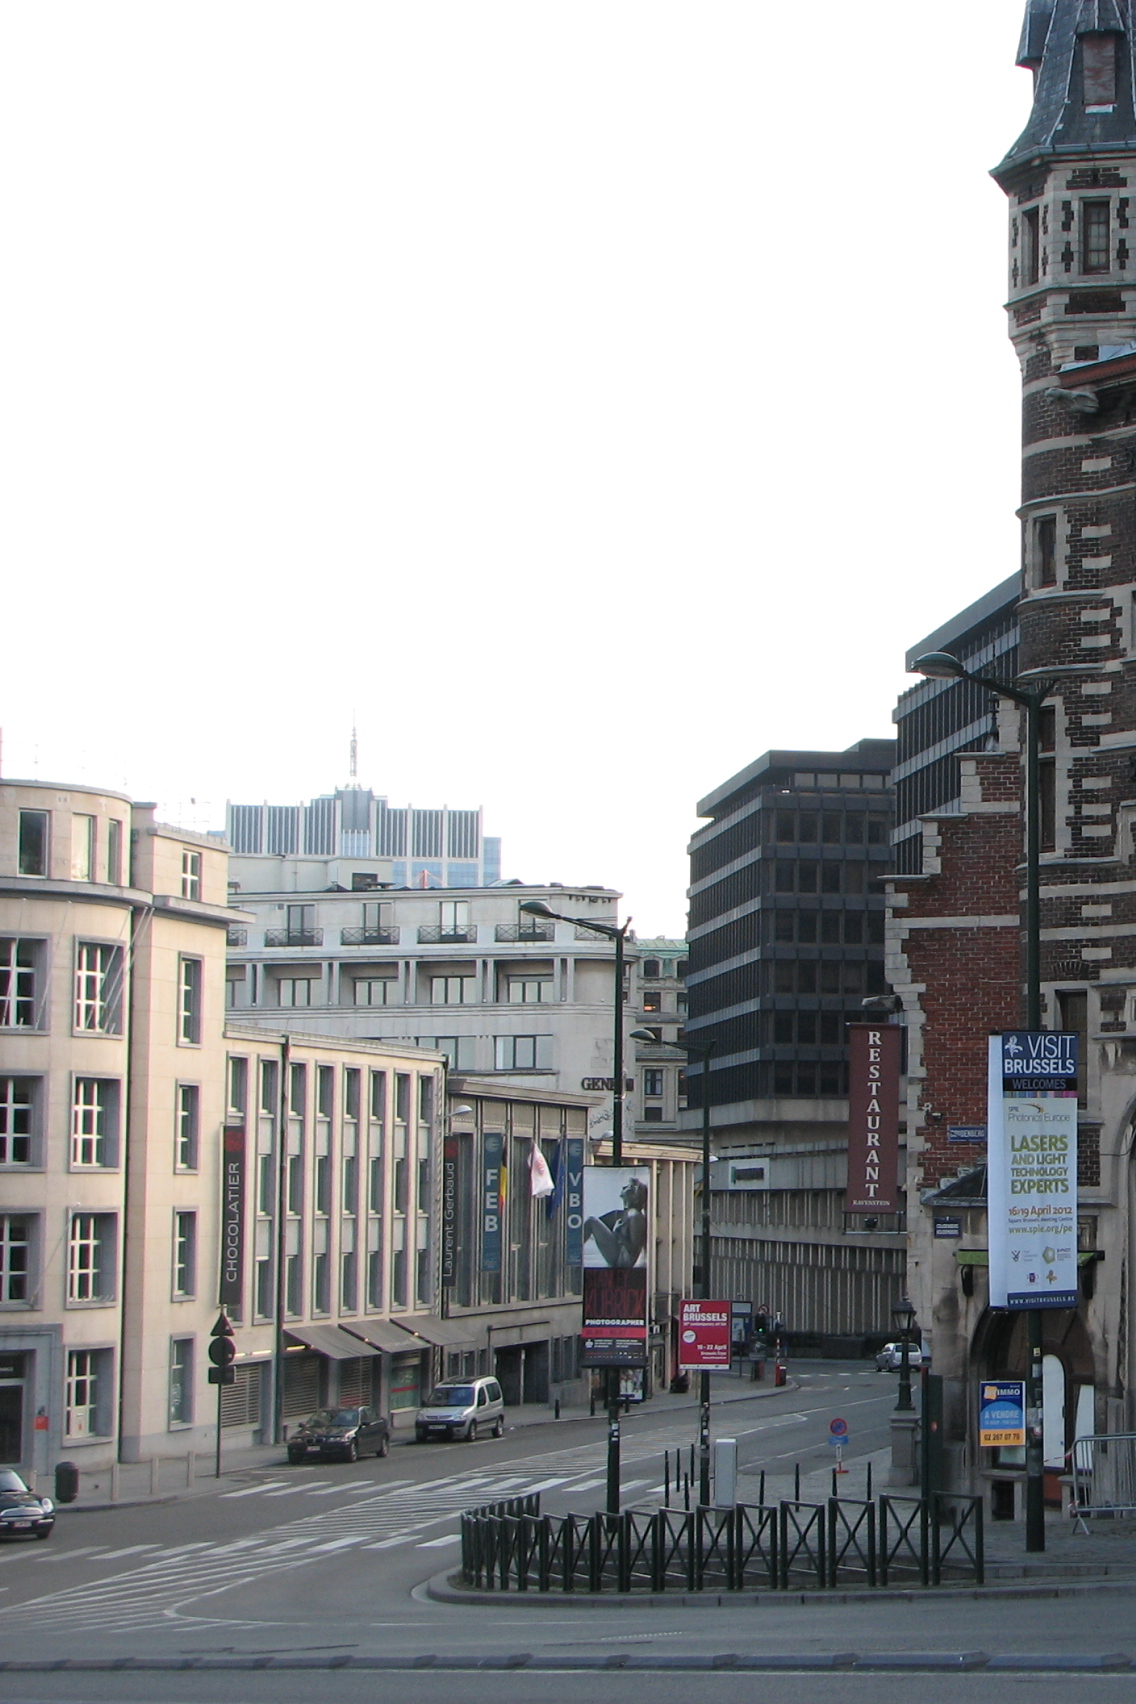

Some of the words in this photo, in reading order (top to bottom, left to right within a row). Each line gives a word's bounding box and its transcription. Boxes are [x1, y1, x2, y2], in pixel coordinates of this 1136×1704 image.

[1028, 1035, 1075, 1058] VISIT
[1004, 1059, 1075, 1073] BRUSSELS
[1012, 1079, 1066, 1089] WELCOMES
[865, 1031, 882, 1197] RESTAURANT
[1008, 1113, 1041, 1122] Photonics
[1043, 1113, 1071, 1122] Europe
[1011, 1135, 1068, 1152] LASERS
[1011, 1154, 1035, 1165] AND
[1036, 1153, 1068, 1165] LIGHT
[1010, 1167, 1068, 1177] TECHNOLOGY
[443, 1162, 455, 1220] Gerbaud
[1011, 1178, 1069, 1194] EXPERTS
[484, 1169, 499, 1232] FEB
[568, 1172, 582, 1229] VBO
[1030, 1204, 1052, 1216] April
[1052, 1206, 1073, 1215] 2012
[225, 1162, 239, 1282] CHOCOLATIER
[1009, 1223, 1073, 1234] www.spie.org/pe
[443, 1224, 454, 1277] Laurent
[683, 1303, 701, 1312] ART
[683, 1313, 727, 1321] BRUSSELS
[991, 1410, 1020, 1419] VENDRE
